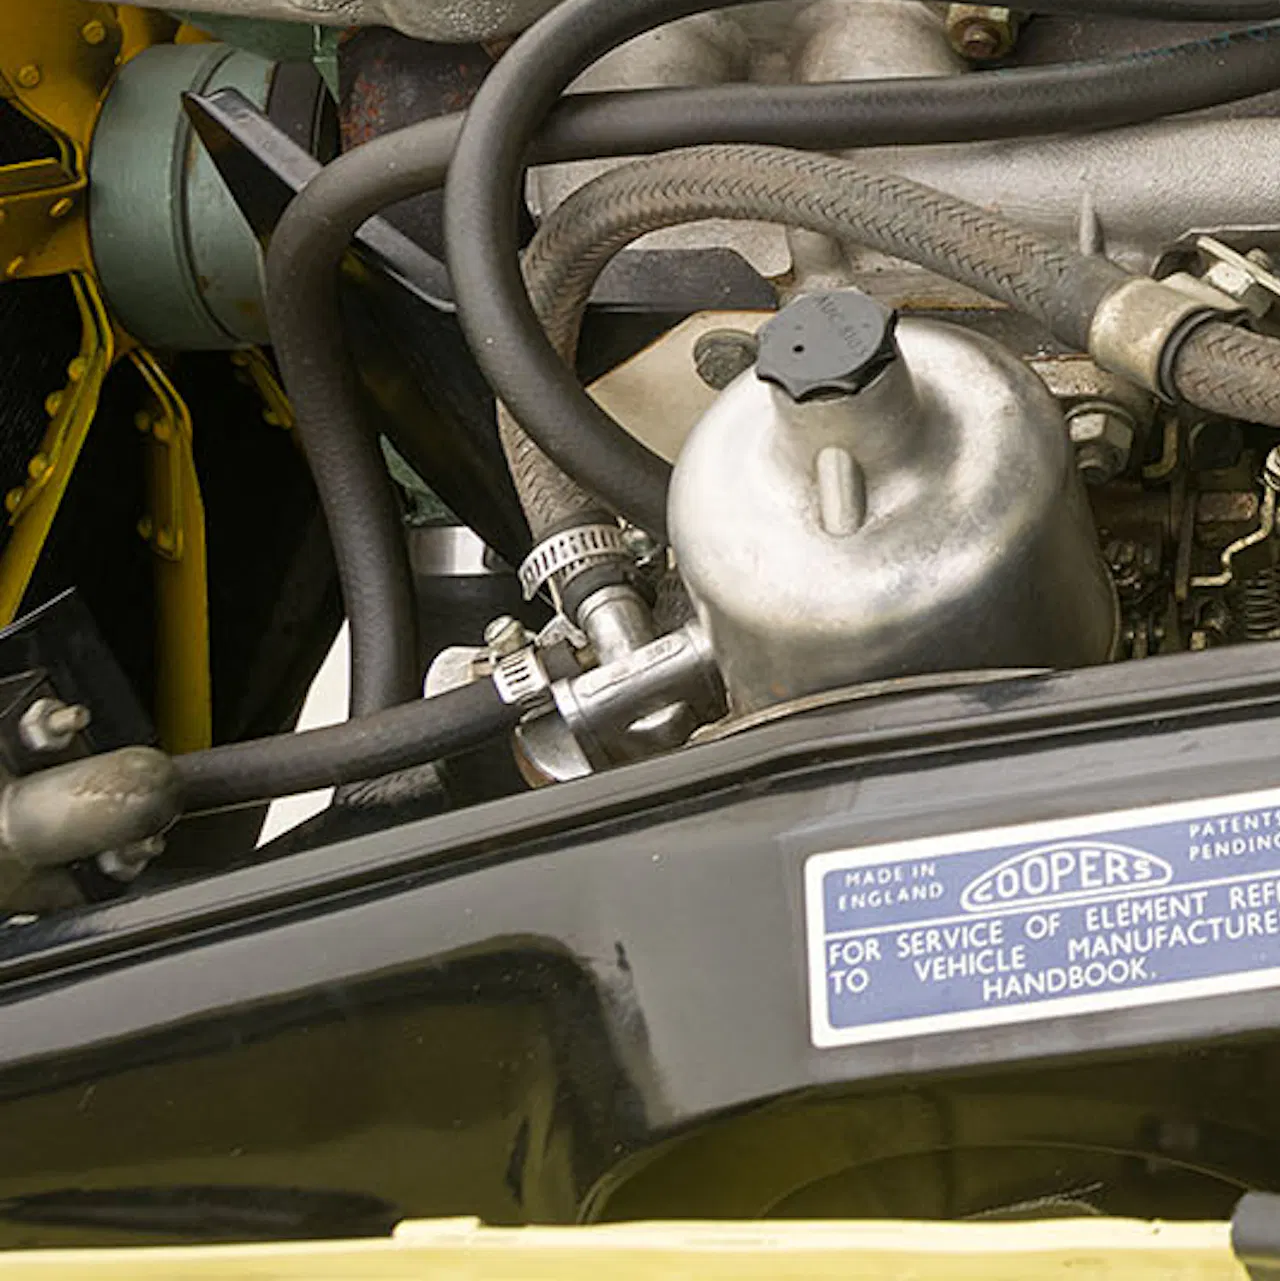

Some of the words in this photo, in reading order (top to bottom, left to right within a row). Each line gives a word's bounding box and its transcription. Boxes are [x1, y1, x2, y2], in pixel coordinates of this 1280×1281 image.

[838, 881, 944, 911] ENGLAND
[844, 867, 903, 888] MADE
[911, 863, 936, 879] IN
[972, 849, 1153, 903] COOPERS
[828, 936, 881, 966] FOR
[896, 920, 1004, 959] SERVICE
[1026, 912, 1062, 940] OF
[1085, 891, 1208, 930] ELEMENT
[828, 968, 869, 995] TO
[914, 945, 1026, 983] VEHICLE
[982, 957, 1158, 1002] HANDBOOK.
